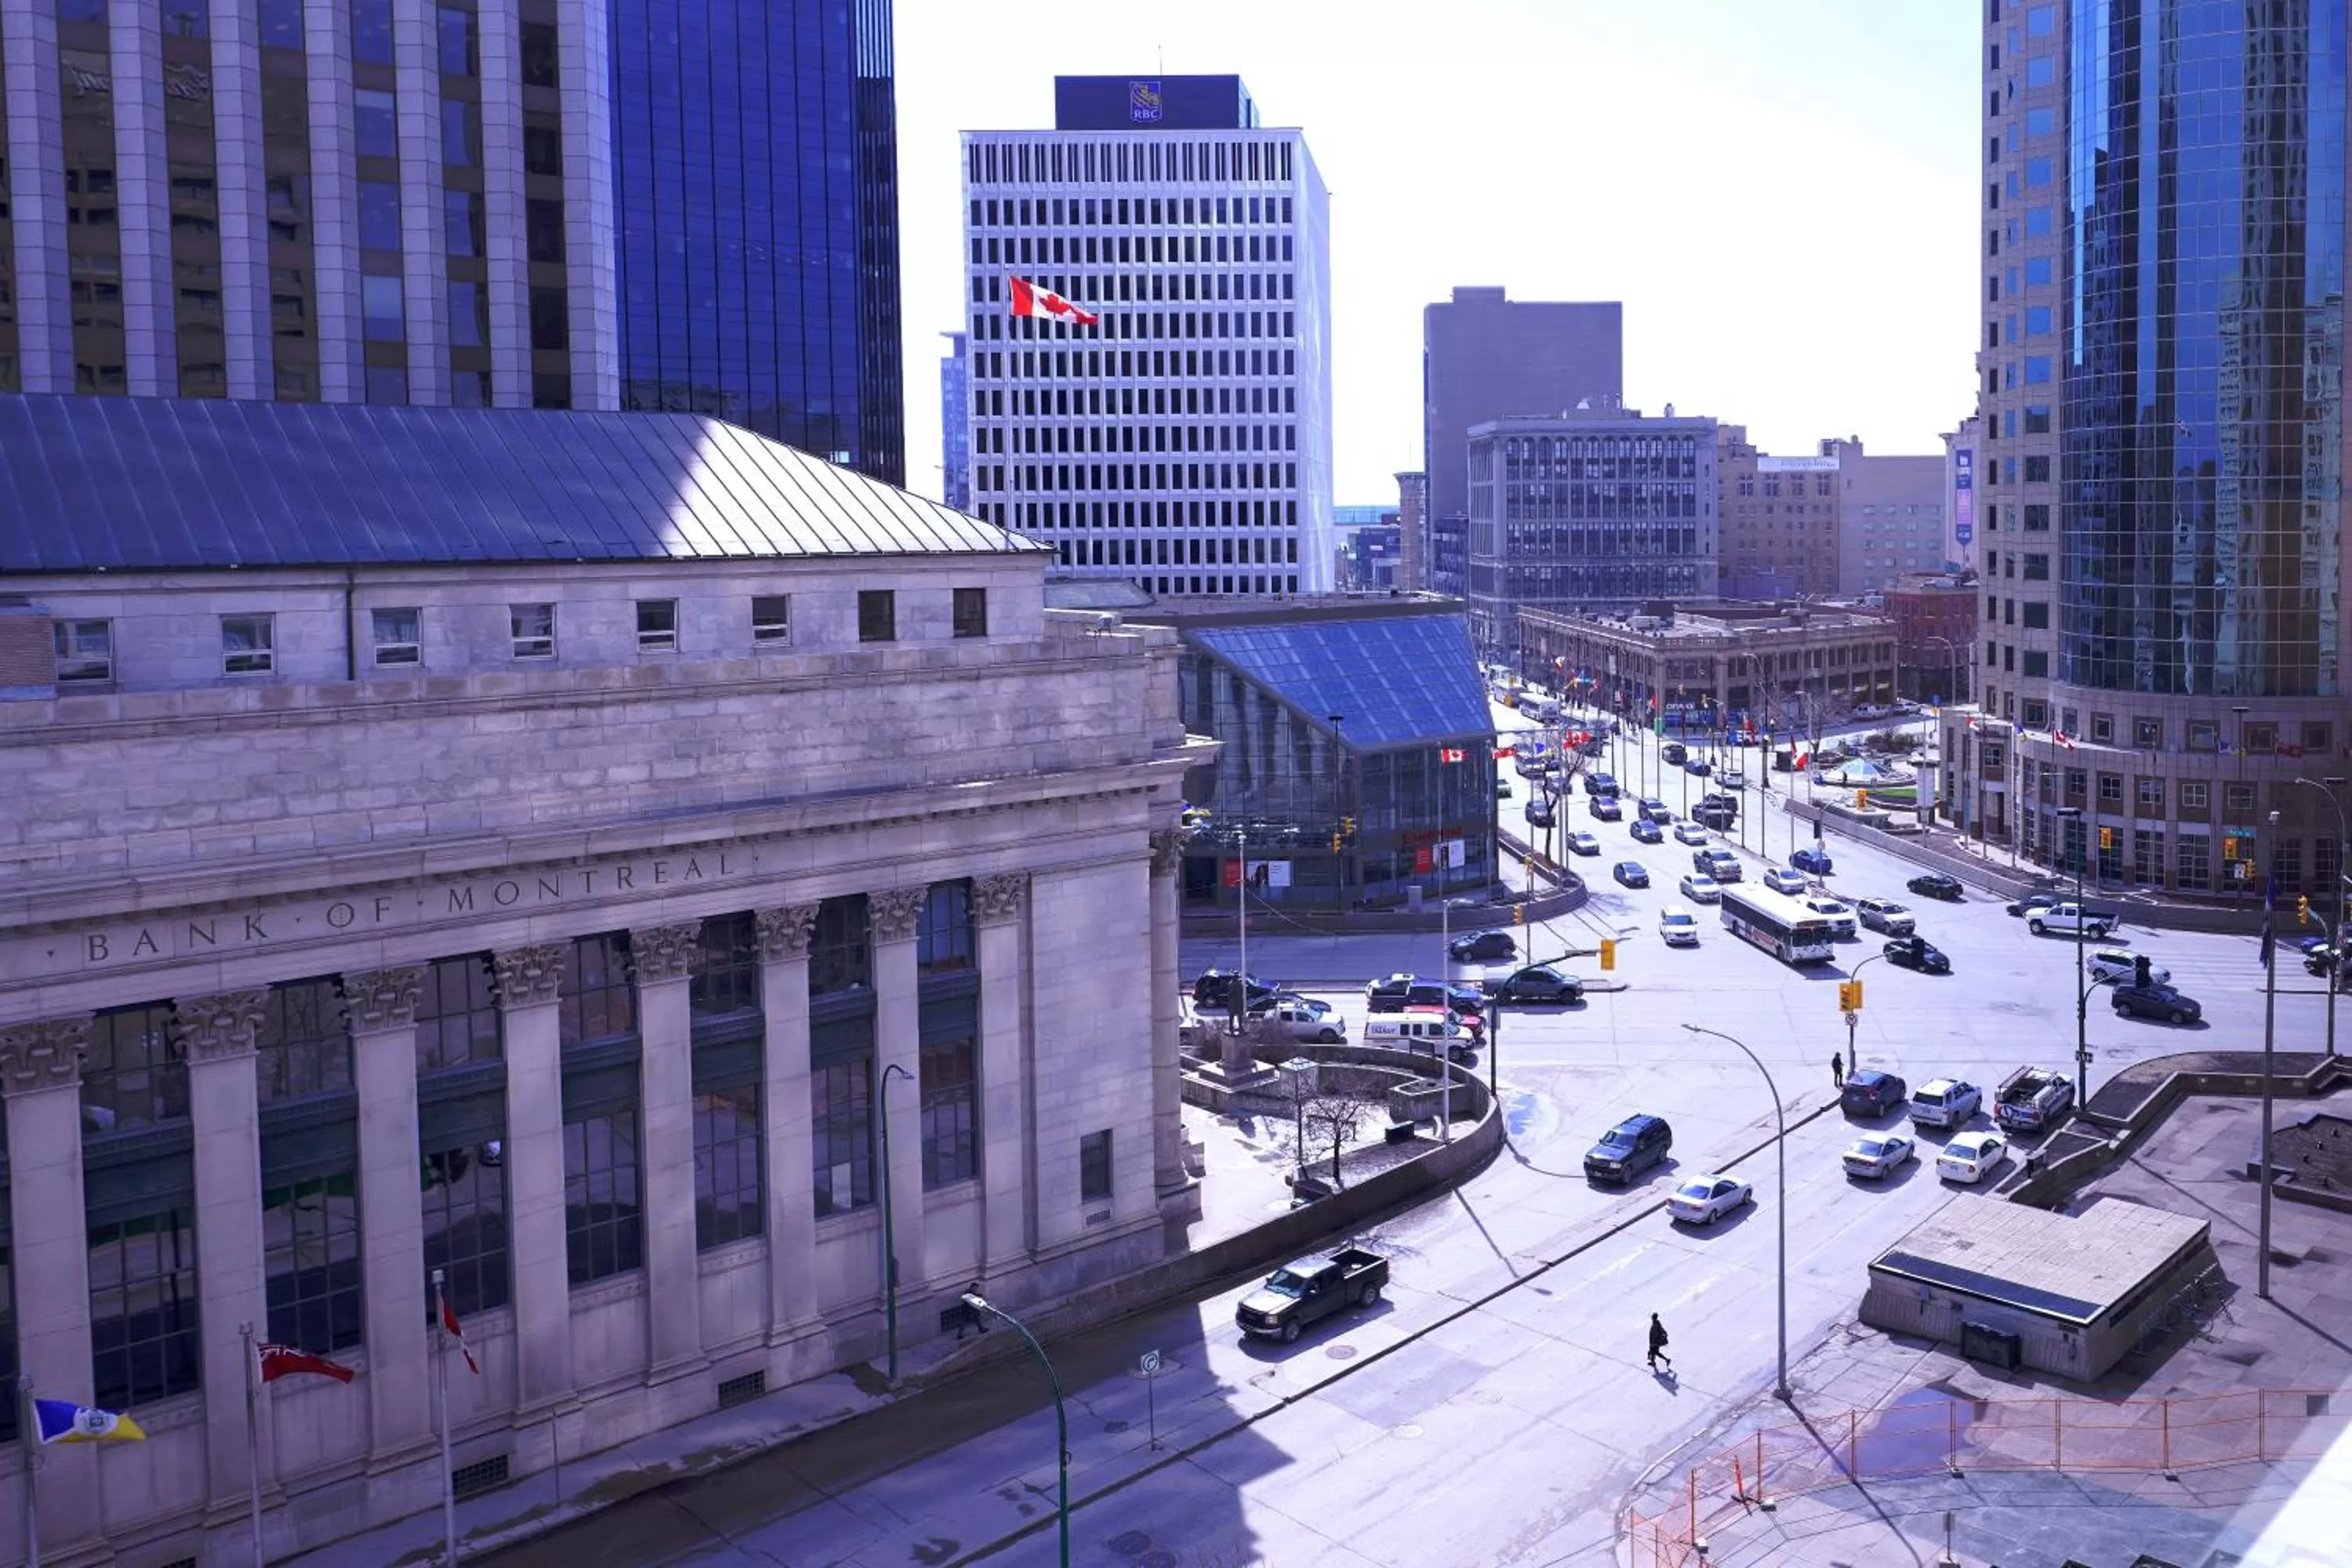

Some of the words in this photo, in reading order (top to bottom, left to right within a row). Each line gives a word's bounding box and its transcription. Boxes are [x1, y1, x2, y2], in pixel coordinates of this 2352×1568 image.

[1134, 109, 1158, 118] RBC
[87, 913, 269, 962] BANK
[326, 895, 392, 928] OF
[448, 853, 735, 913] MONTREAL
